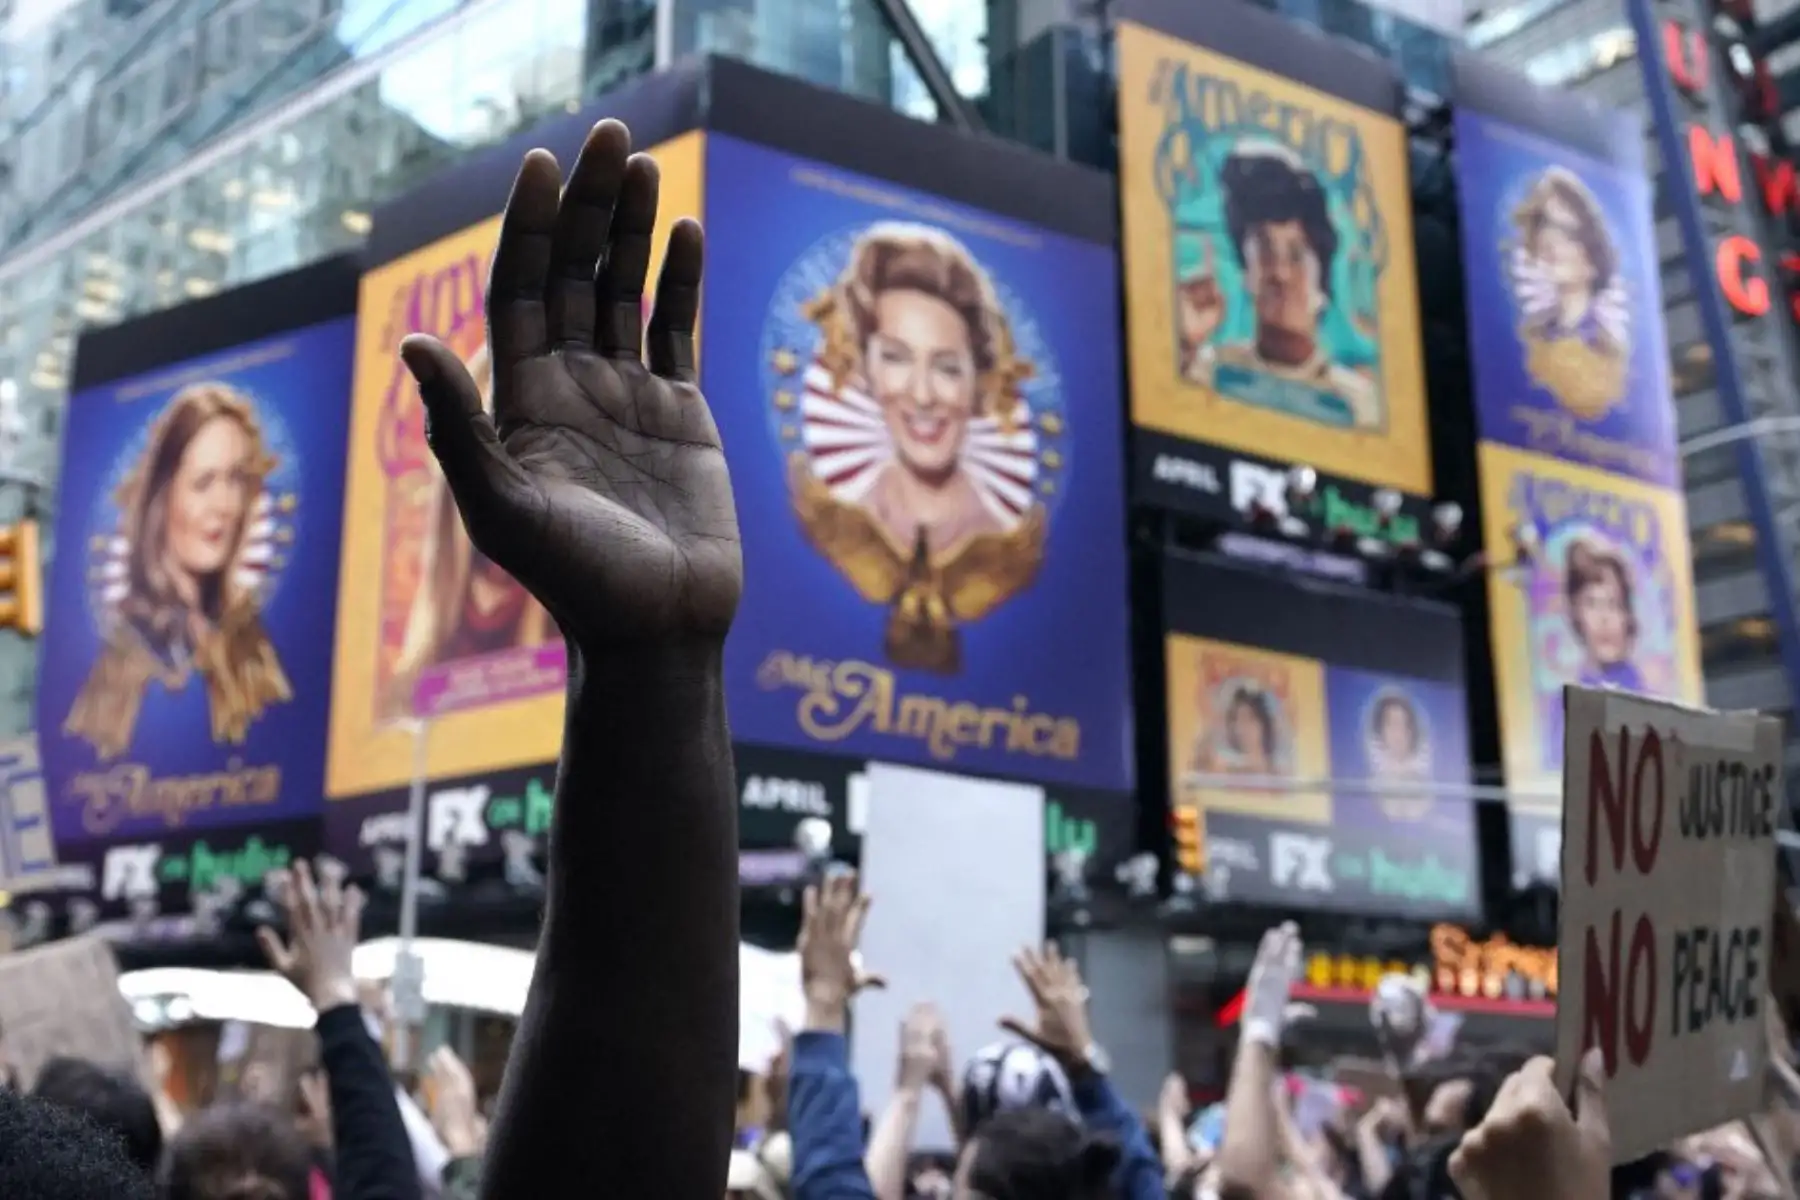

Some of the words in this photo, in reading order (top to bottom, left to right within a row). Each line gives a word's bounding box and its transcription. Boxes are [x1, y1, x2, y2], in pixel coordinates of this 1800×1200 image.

[1229, 459, 1289, 520] FX
[797, 657, 1081, 760] America
[428, 784, 490, 851] FX
[741, 773, 833, 816] APRIL
[1584, 722, 1664, 887] NO
[1678, 759, 1777, 840] JUSTICE
[1269, 831, 1333, 893] FX
[1580, 907, 1658, 1080] NO
[1671, 926, 1762, 1037] PEACE
